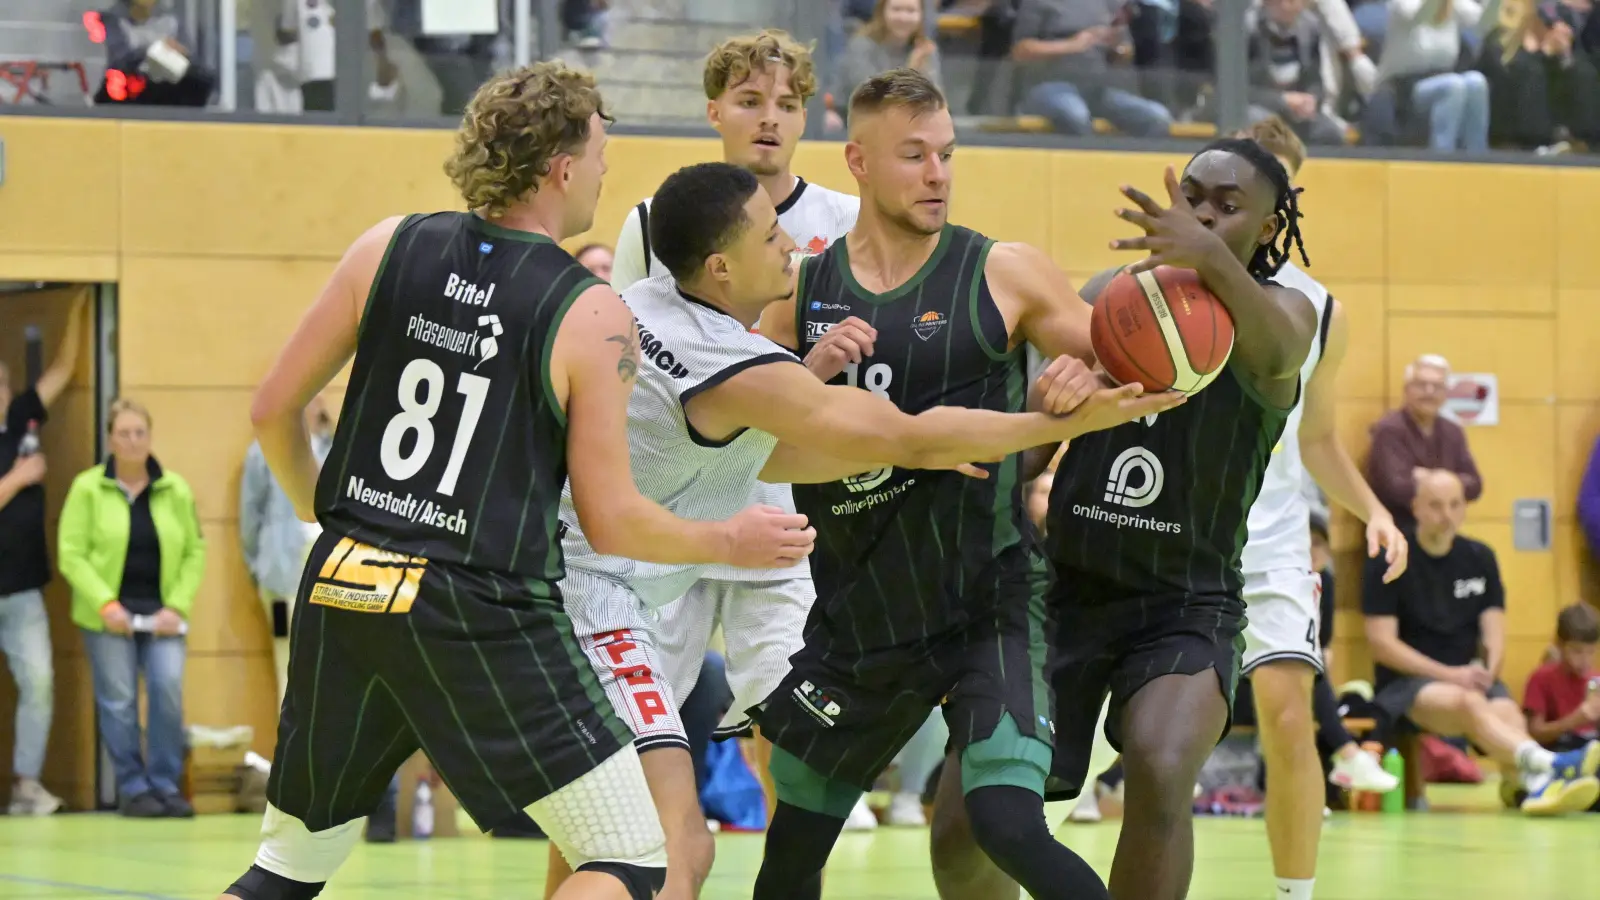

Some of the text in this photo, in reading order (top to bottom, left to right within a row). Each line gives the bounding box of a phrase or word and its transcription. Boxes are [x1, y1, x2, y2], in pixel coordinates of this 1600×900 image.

[444, 272, 496, 307] Bittel
[406, 313, 480, 357] phasenwerk
[380, 358, 491, 497] 81
[346, 475, 468, 535] Neustadt/Aisch
[1072, 503, 1182, 534] onlineprinters
[315, 585, 388, 604] STIRLING INDUSTRIE
[1305, 618, 1316, 652] 4
